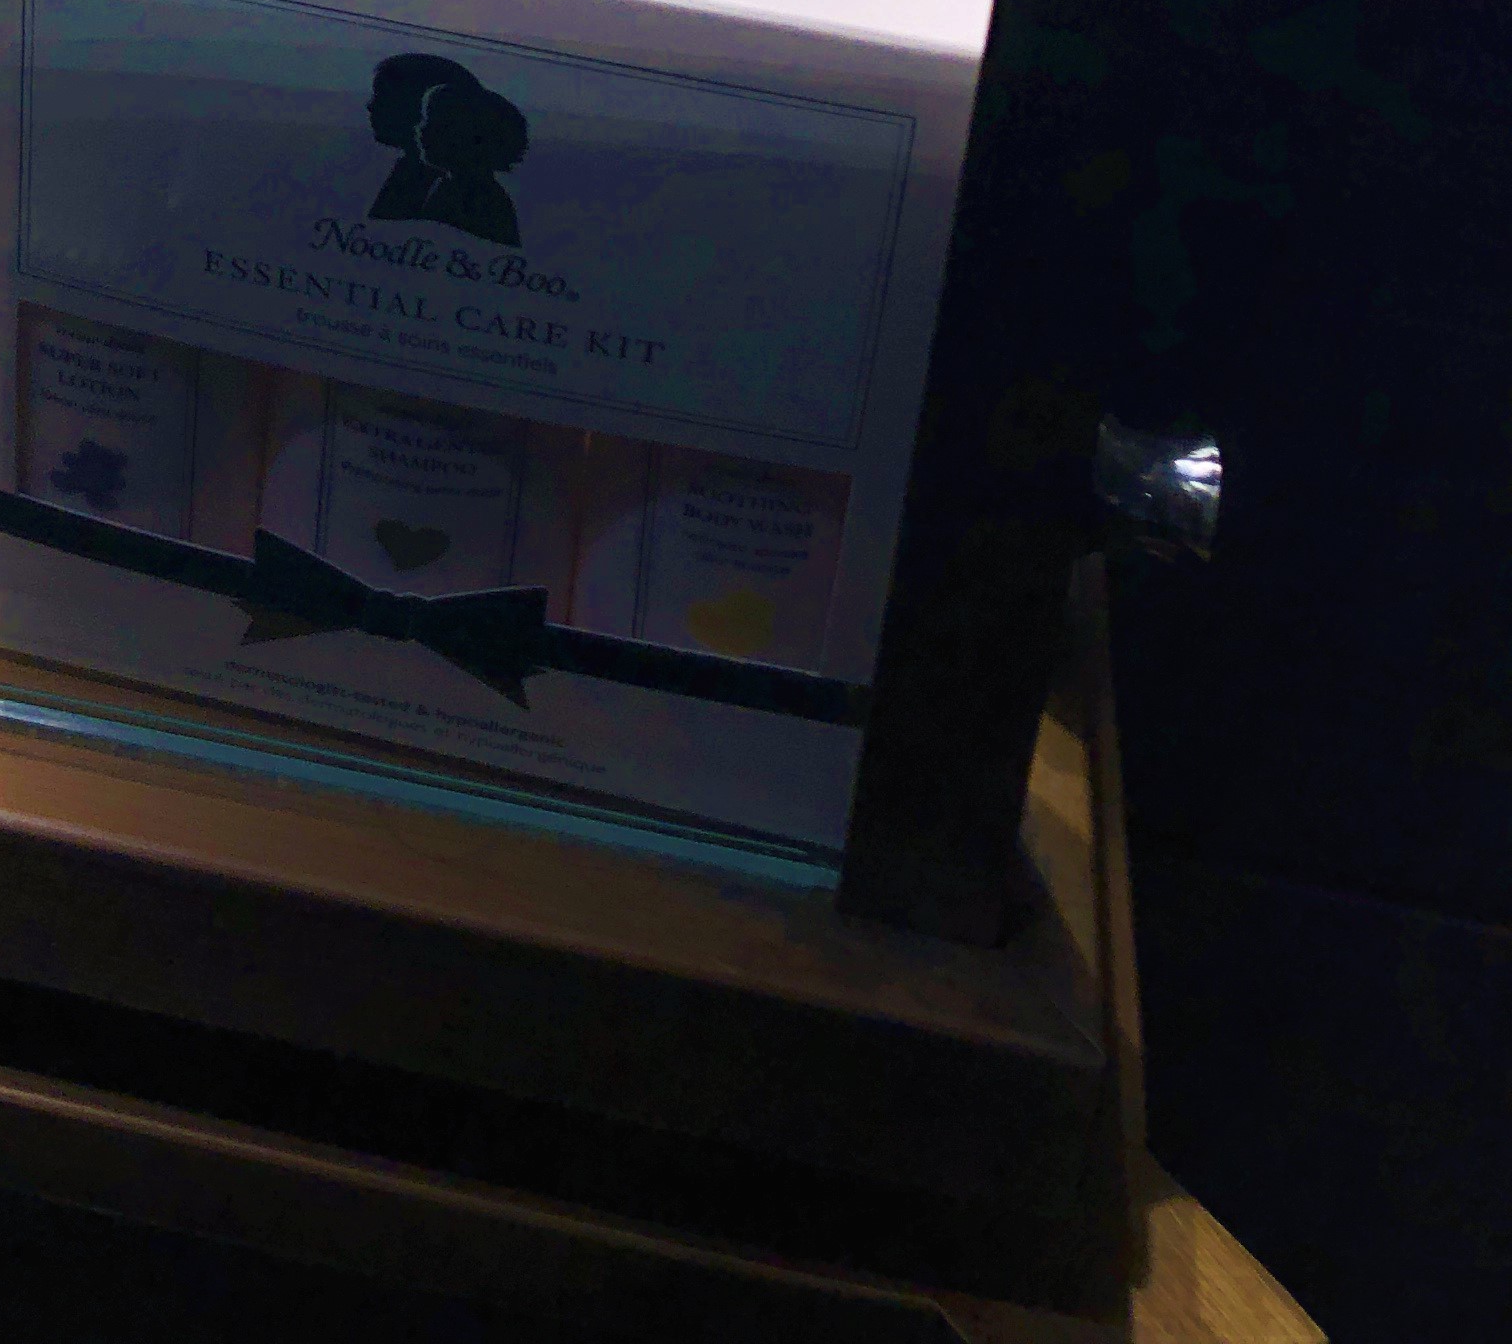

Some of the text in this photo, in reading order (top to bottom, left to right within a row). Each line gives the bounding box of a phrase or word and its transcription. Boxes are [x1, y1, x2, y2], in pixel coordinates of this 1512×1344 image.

[309, 217, 439, 272] Noodle
[446, 249, 482, 282] &
[204, 248, 666, 365] ESSENTIAL CARE KIT
[398, 331, 450, 355] soins
[457, 344, 558, 376] essentiels
